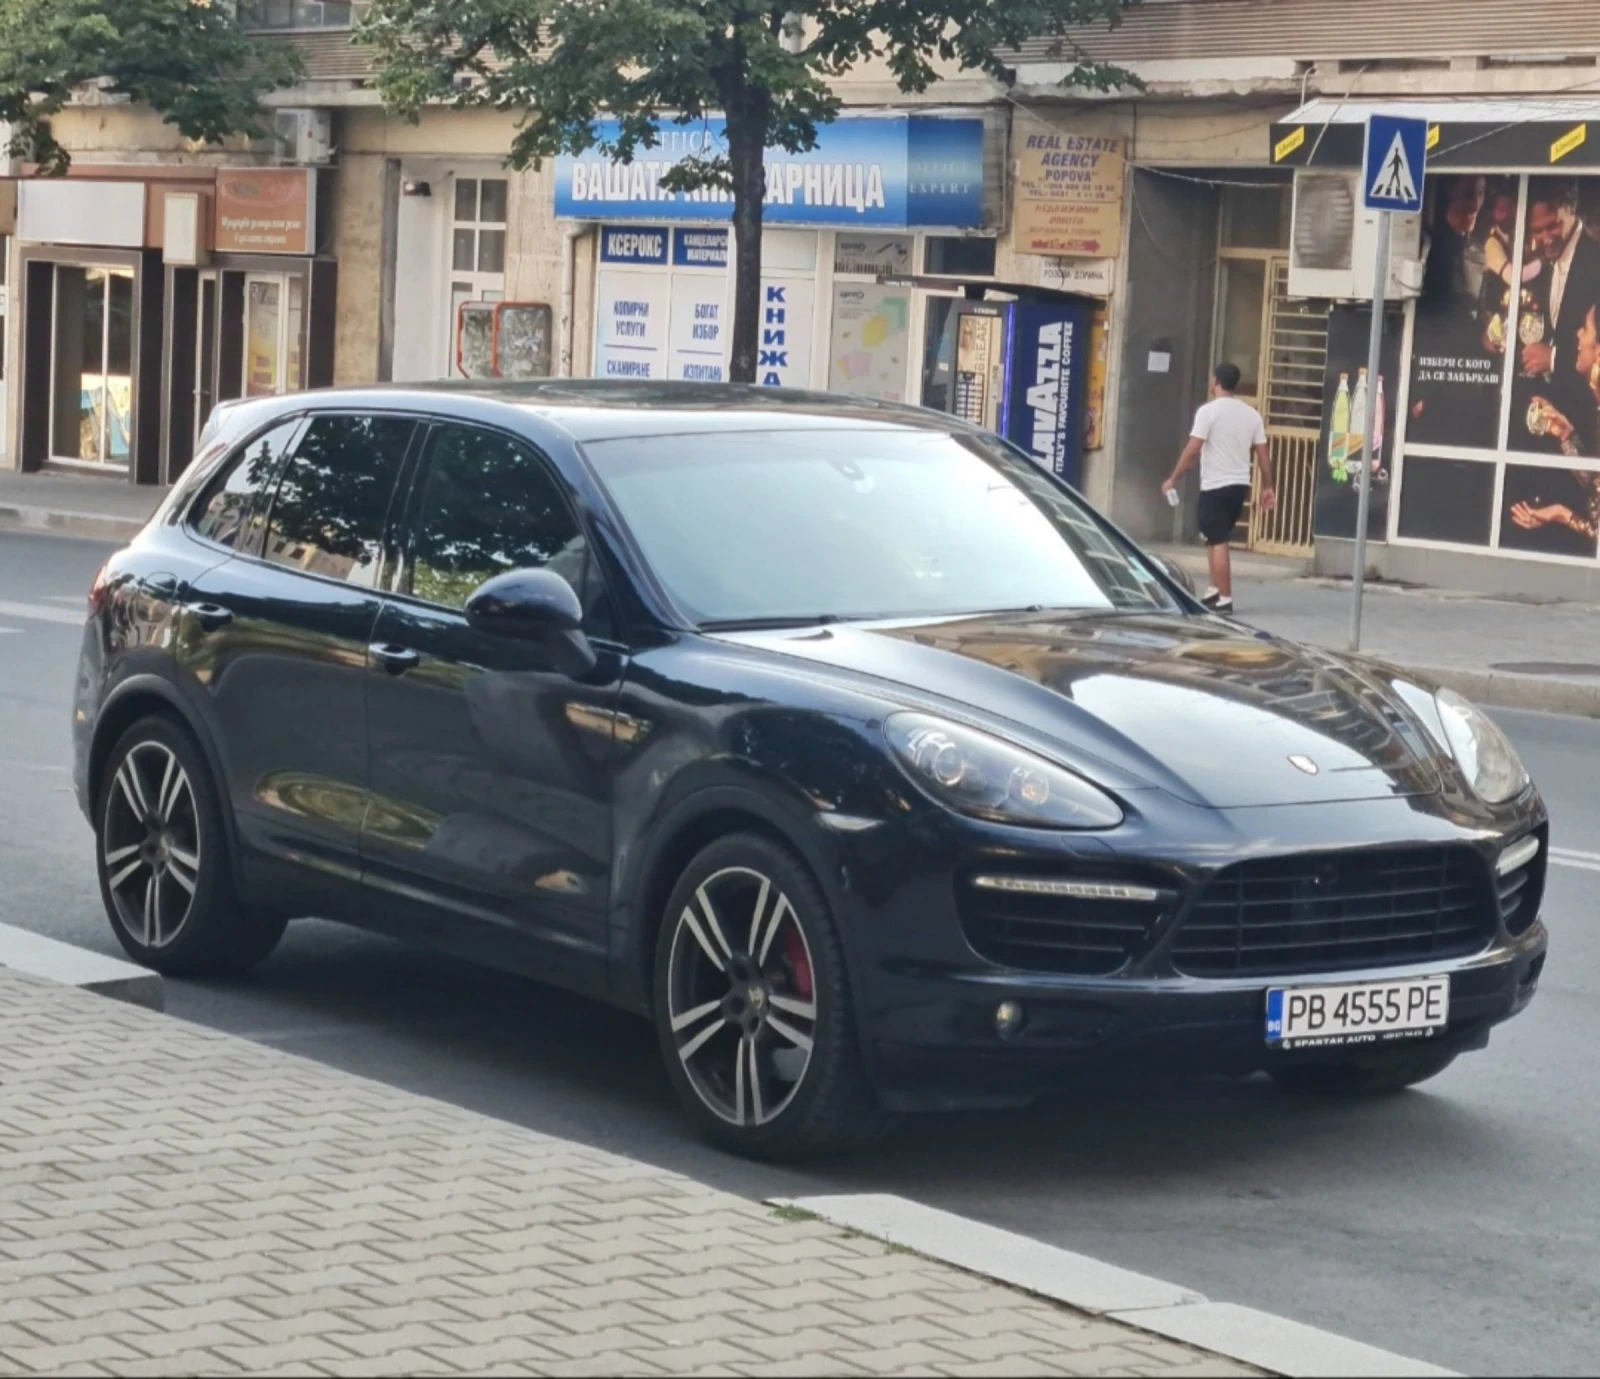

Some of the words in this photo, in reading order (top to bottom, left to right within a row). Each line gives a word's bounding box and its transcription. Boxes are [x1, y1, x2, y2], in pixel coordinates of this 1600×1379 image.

[1026, 135, 1062, 149] REAL
[1066, 137, 1119, 153] ESTATE
[1041, 154, 1099, 168] AGENCY
[909, 183, 969, 194] EXPERT
[608, 233, 662, 257] КСЕРОКС
[613, 300, 649, 317] КОПИРНИ
[694, 304, 719, 320] БОГАТ
[616, 321, 646, 337] УСЛУГИ
[692, 324, 719, 340] ИЗБОР
[1062, 321, 1073, 365] COFFEE
[607, 360, 650, 377] СКАНИРАНЕ
[1420, 356, 1455, 367] ИЗБЕРИ
[1457, 358, 1464, 368] С
[1466, 359, 1491, 370] КОГО
[1418, 370, 1431, 382] ДА
[1433, 371, 1445, 381] СЕ
[1447, 371, 1499, 384] ЗАБЪРКАШ
[1026, 321, 1063, 473] LAVAZZA
[1058, 368, 1071, 429] FAVOURITE
[1055, 432, 1066, 472] ITALY'S
[1288, 994, 1326, 1031] PB
[1333, 989, 1400, 1028] 4555
[1407, 985, 1442, 1022] PE
[1267, 1020, 1281, 1032] BG
[1294, 1036, 1344, 1047] SPARTAK
[1346, 1034, 1376, 1043] AUTO
